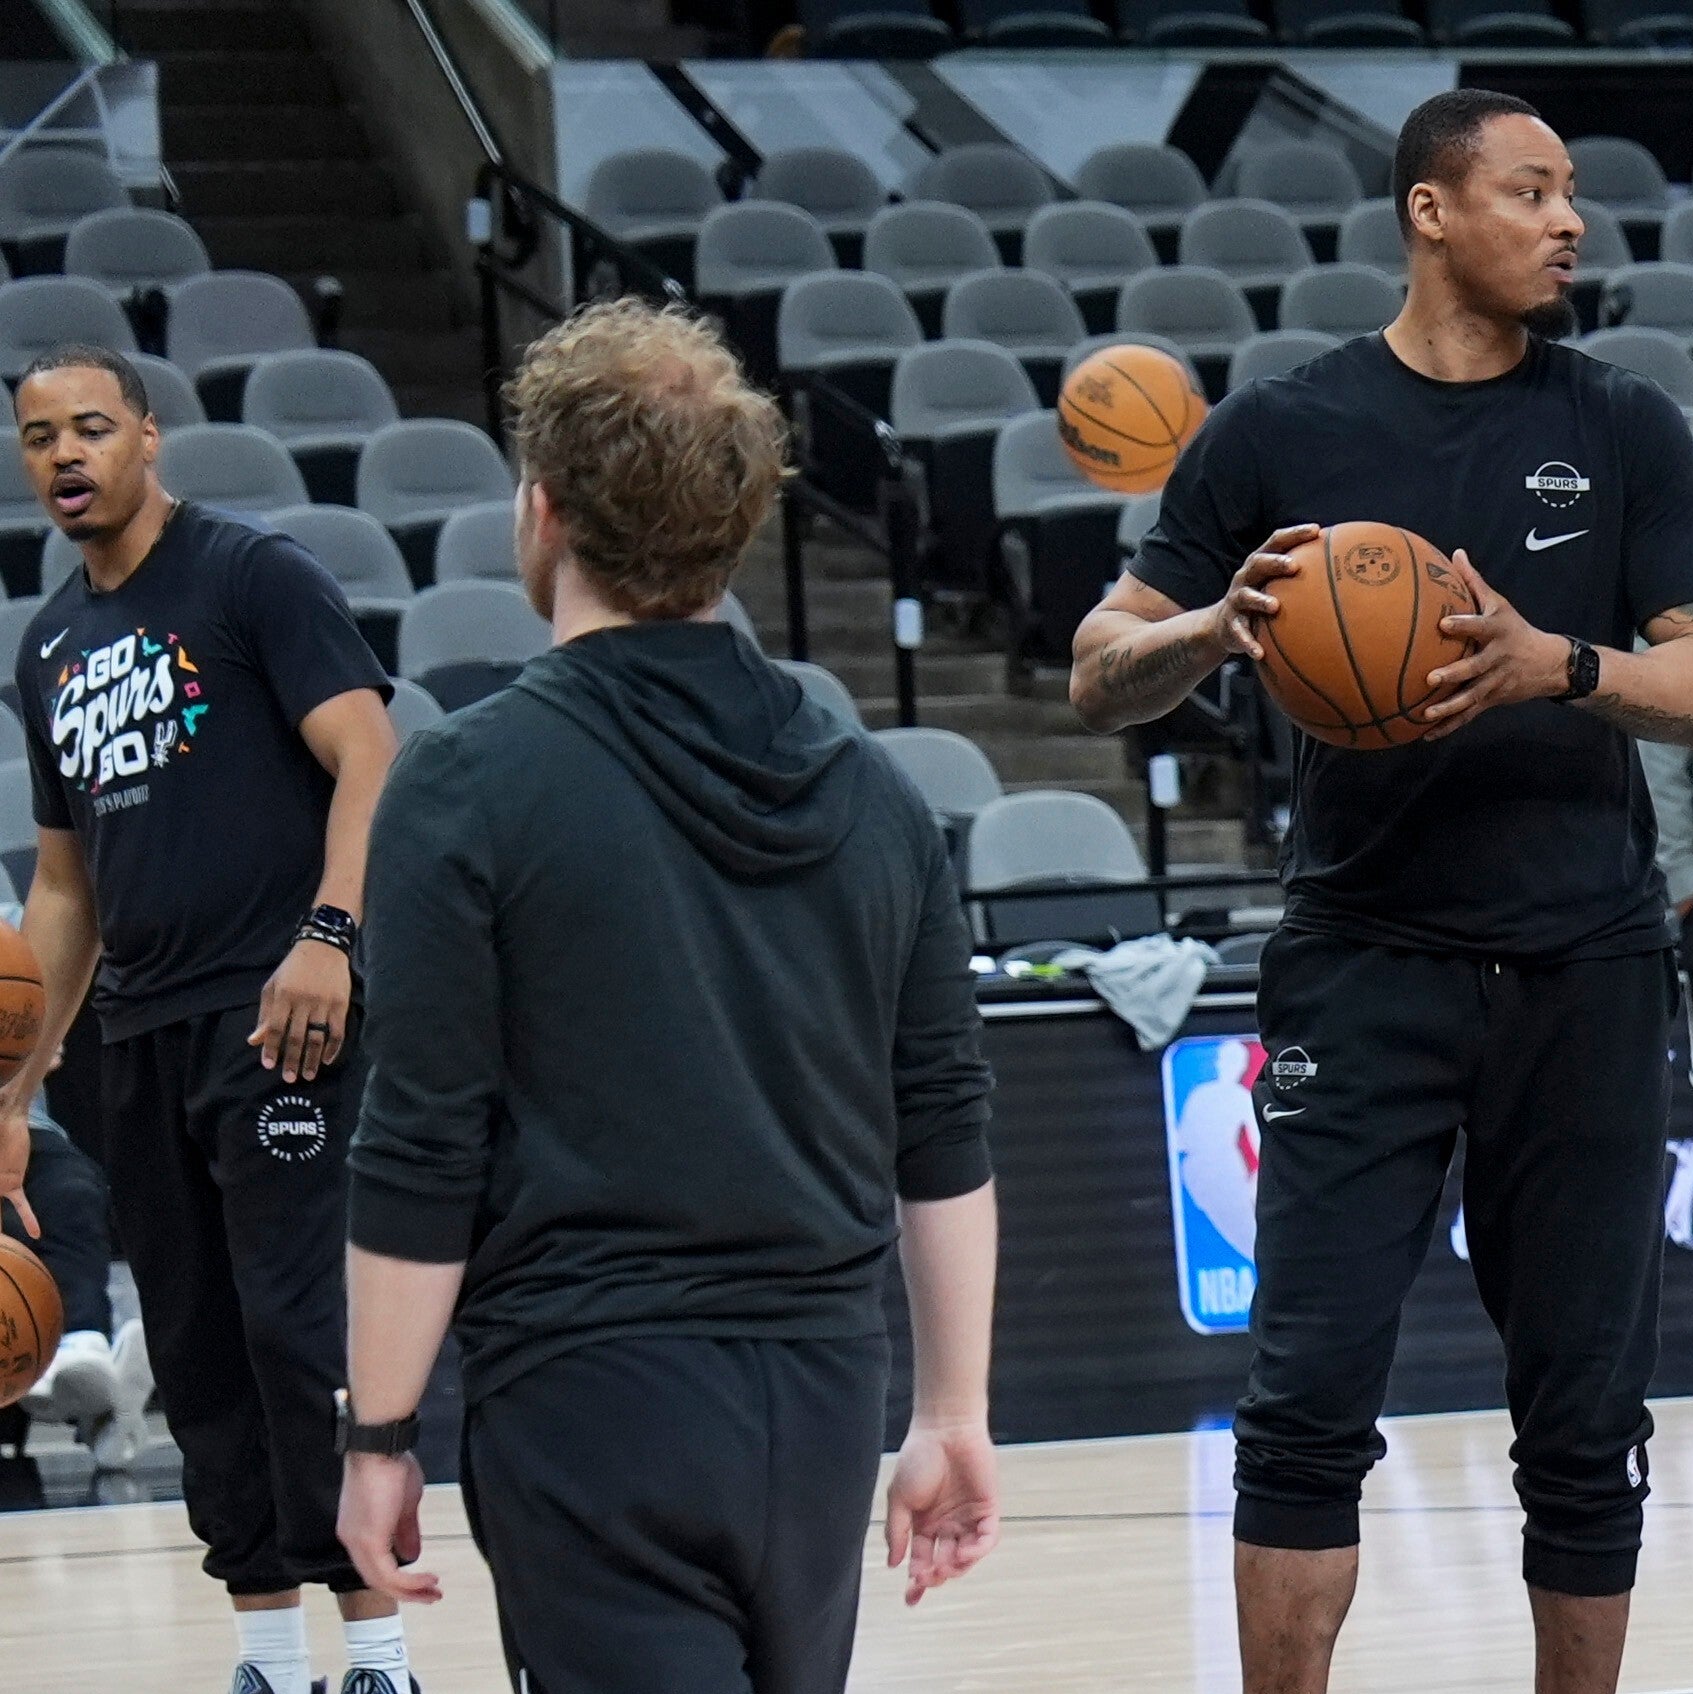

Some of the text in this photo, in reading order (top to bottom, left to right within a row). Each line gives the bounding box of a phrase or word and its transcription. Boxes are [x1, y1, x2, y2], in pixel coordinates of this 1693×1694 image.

[1537, 478, 1579, 489] SPURS
[86, 634, 136, 690] GO
[52, 653, 175, 778] Spurs
[99, 730, 149, 785] GO
[1277, 1063, 1308, 1074] SPURS
[267, 1121, 318, 1136] SPURS
[1198, 1265, 1256, 1316] NBA
